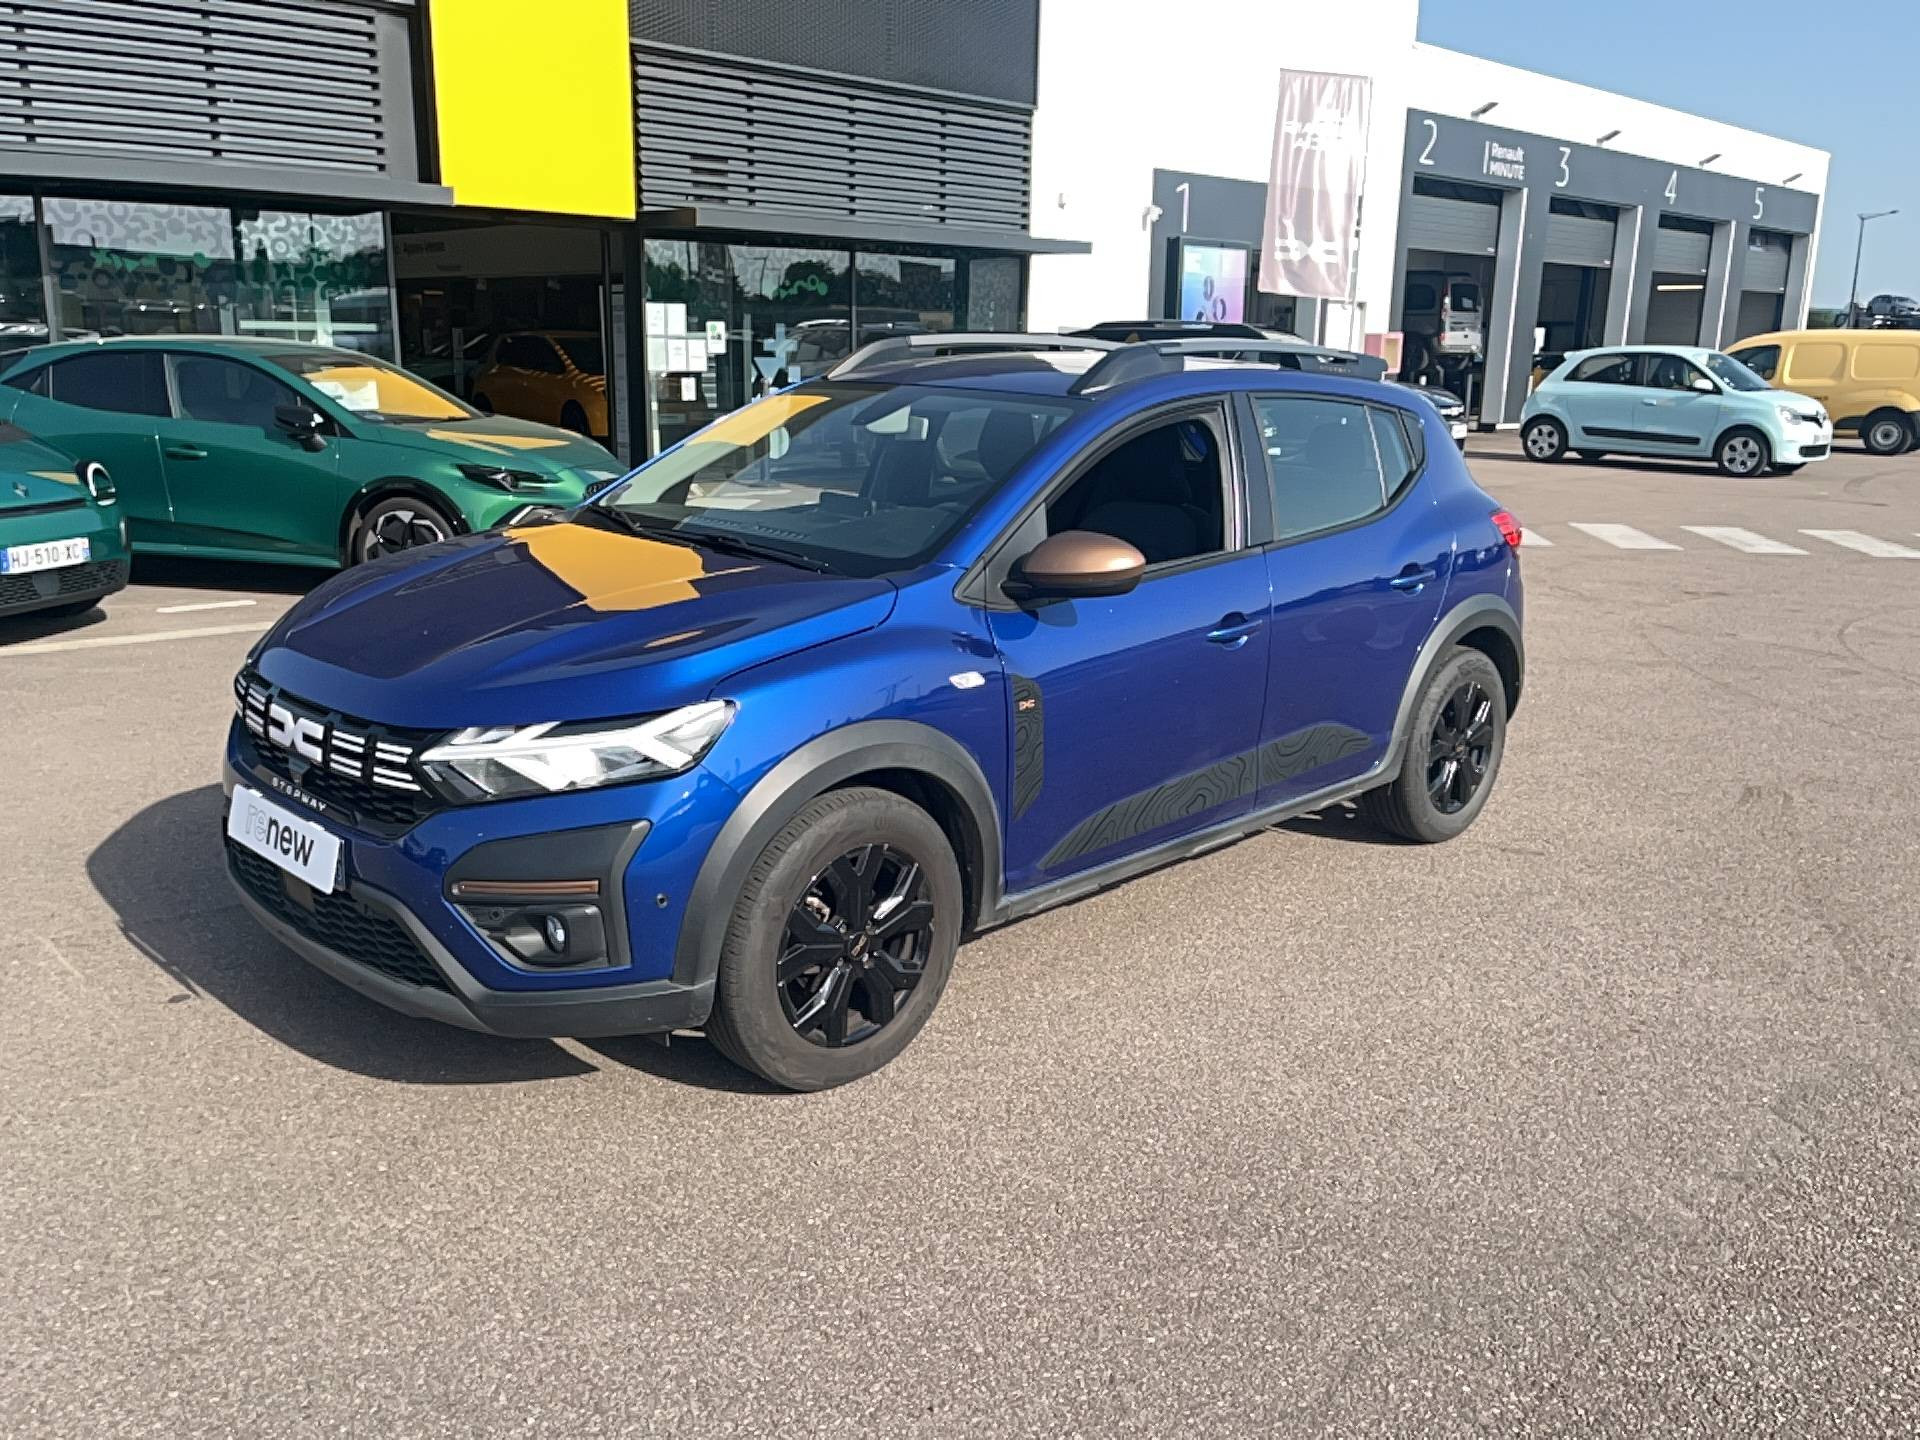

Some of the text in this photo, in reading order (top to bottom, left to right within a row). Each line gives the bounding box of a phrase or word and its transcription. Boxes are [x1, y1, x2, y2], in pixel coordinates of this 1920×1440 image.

[1418, 119, 1437, 165] 2
[1491, 142, 1525, 162] Renault
[1489, 160, 1525, 181] MINUTE
[1555, 146, 1571, 187] 3
[1664, 170, 1679, 205] 4
[1752, 187, 1765, 220] 5
[1175, 182, 1189, 233] 1
[272, 777, 327, 812] STEPWAY
[246, 803, 315, 868] renew
